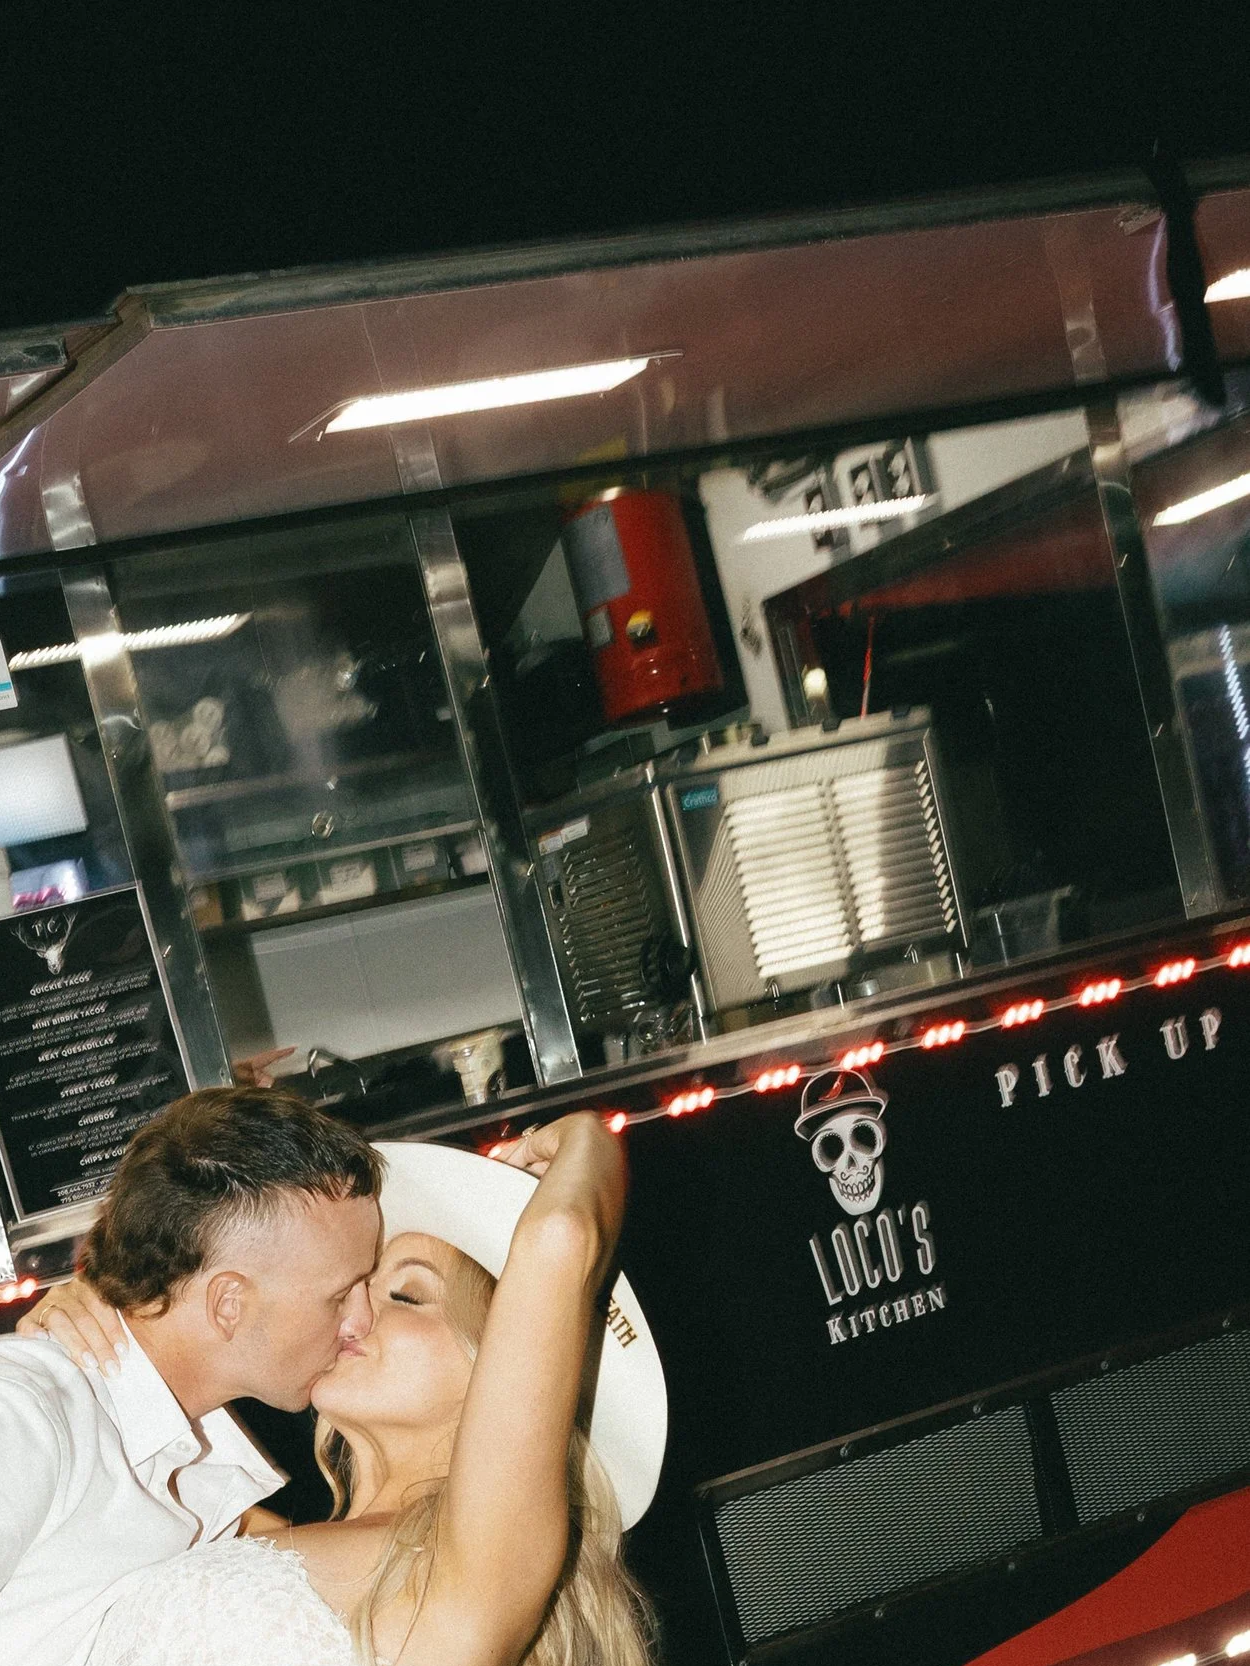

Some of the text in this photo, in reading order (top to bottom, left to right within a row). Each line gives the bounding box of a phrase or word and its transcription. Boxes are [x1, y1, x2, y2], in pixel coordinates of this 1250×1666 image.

[29, 974, 90, 996] QUICKIE TACOS
[30, 1005, 106, 1030] MINI BIRRIA TACOS
[37, 1037, 114, 1063] MEAT QUESADILLAS
[995, 1010, 1223, 1108] PICK UP
[59, 1077, 116, 1098] STREET TACOS
[76, 1110, 115, 1127] CHURROS
[78, 1153, 103, 1166] CHIPS
[809, 1203, 934, 1306] LOCO'S
[607, 1295, 638, 1348] ATH
[825, 1286, 946, 1345] KITCHEN
